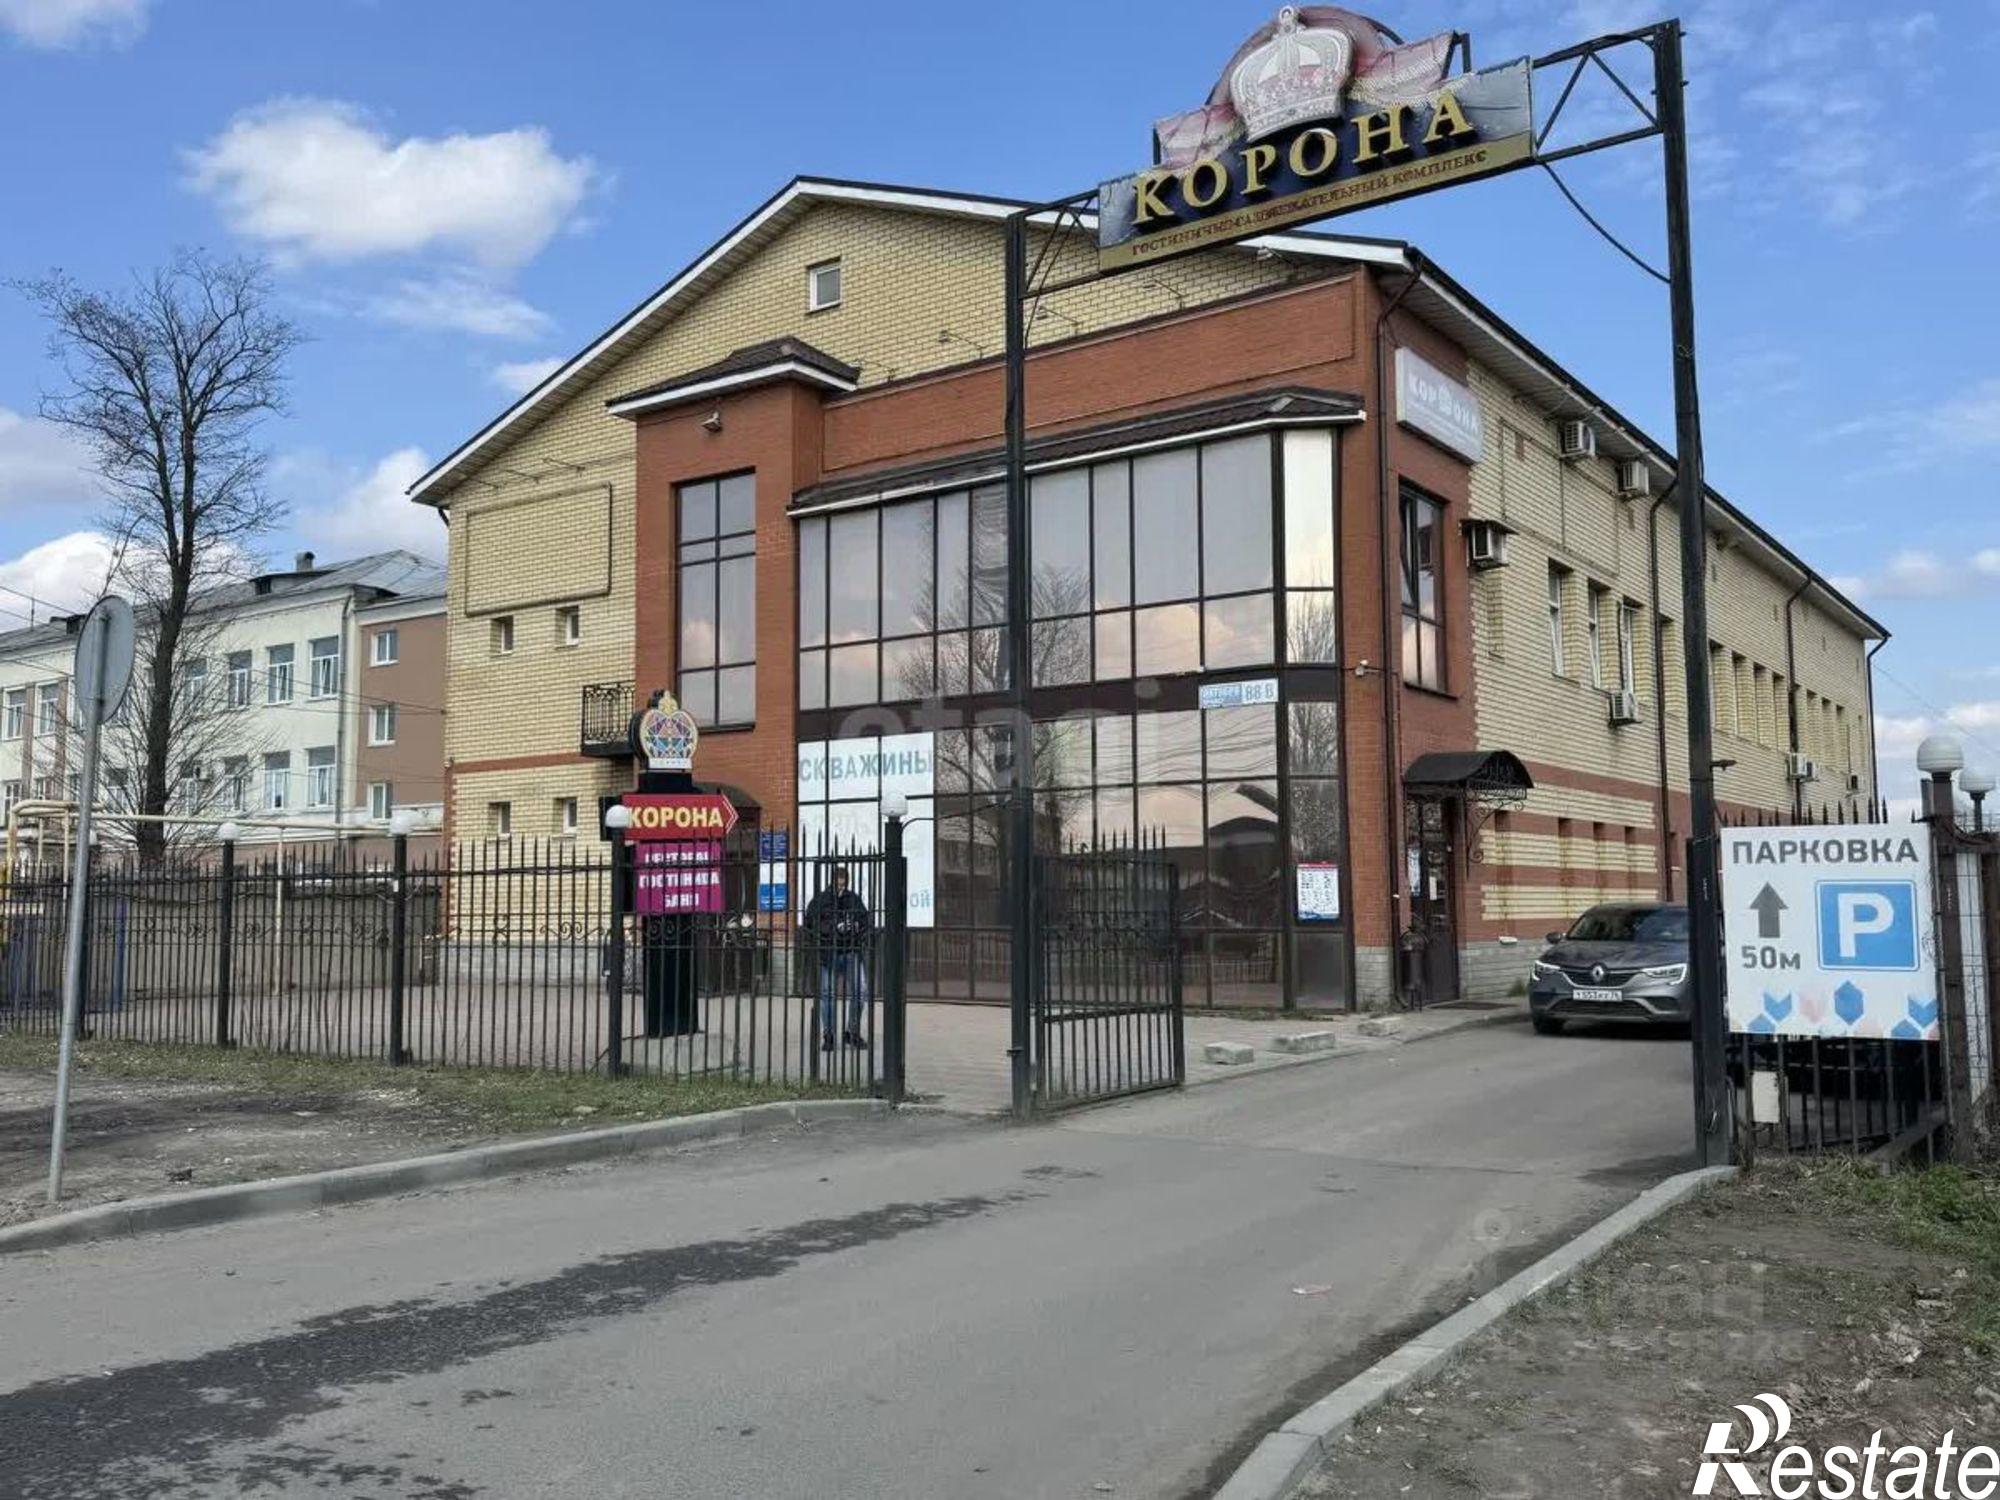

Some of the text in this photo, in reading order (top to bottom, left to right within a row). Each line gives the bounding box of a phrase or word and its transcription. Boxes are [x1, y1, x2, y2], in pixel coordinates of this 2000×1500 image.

[1131, 87, 1474, 225] КОРОНА
[1393, 150, 1487, 185] КОМПЛЕКС
[629, 806, 724, 828] КОРОНА
[1732, 838, 1919, 864] ПАРКОВКА
[1741, 945, 1801, 970] 50м
